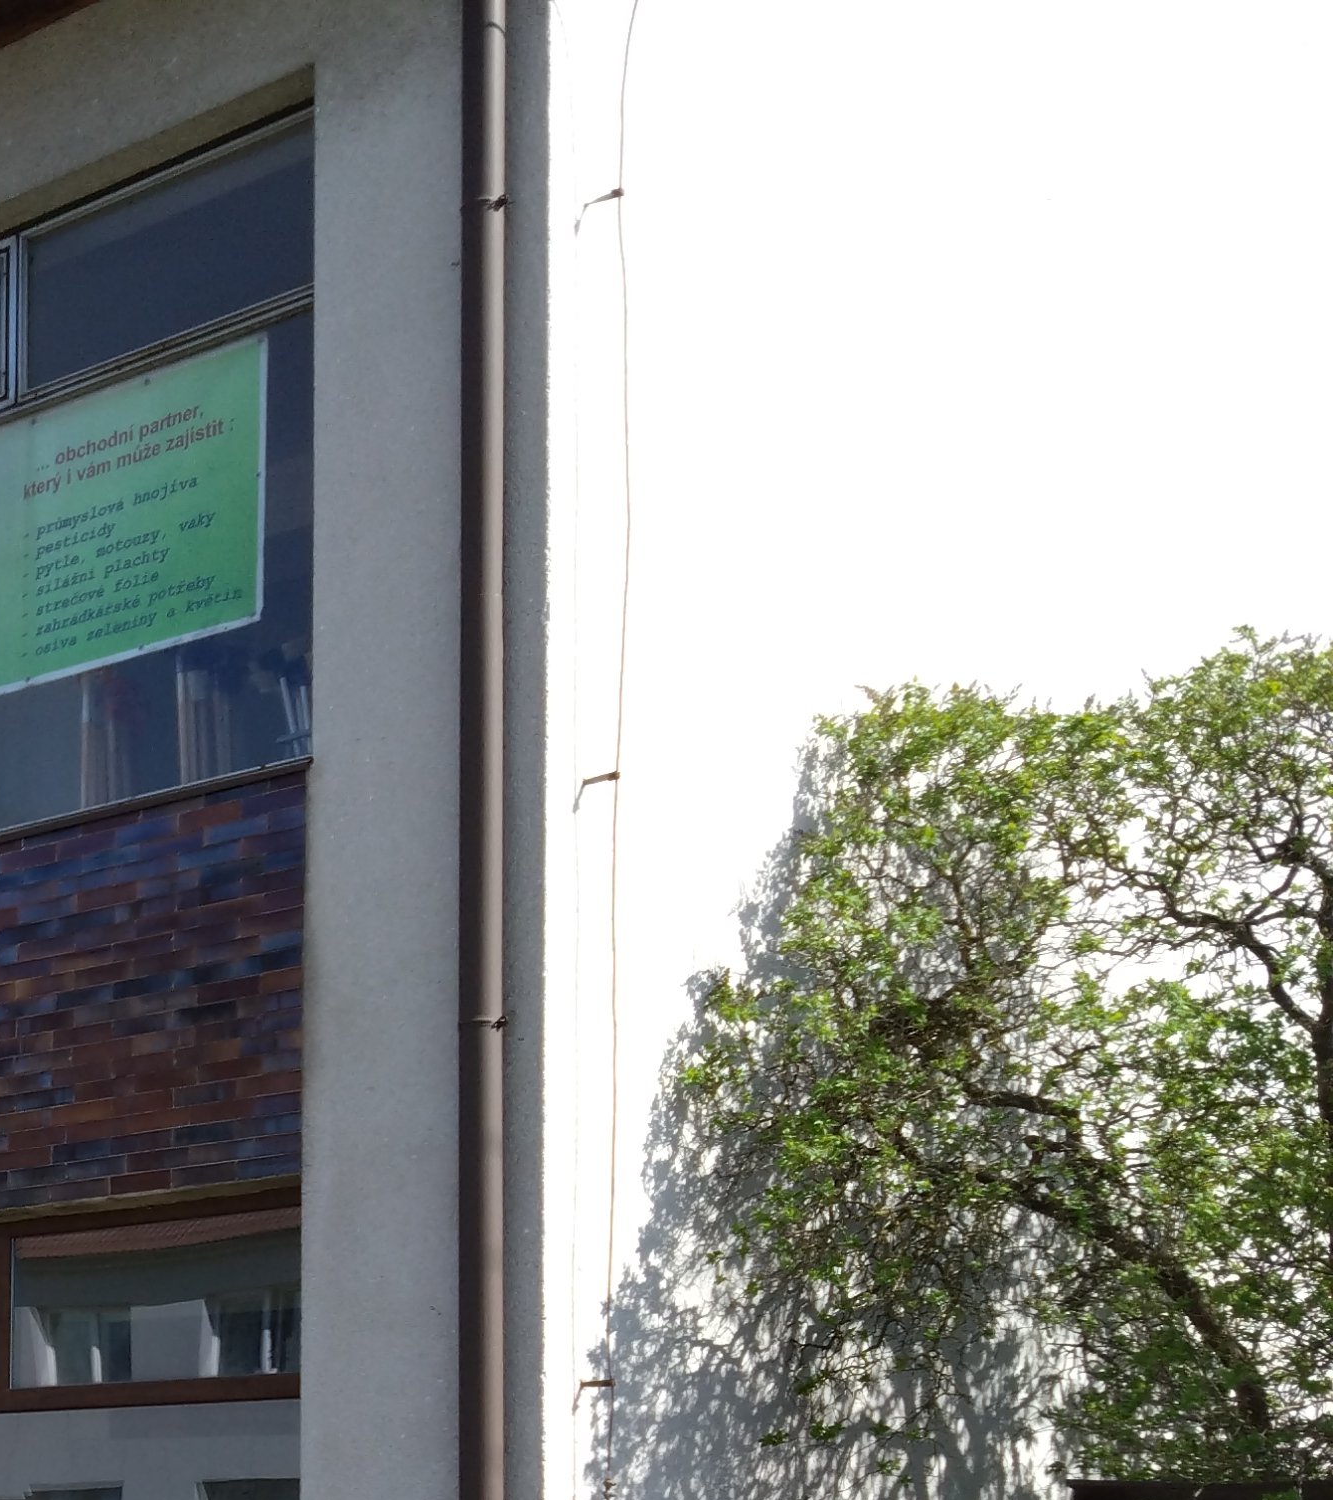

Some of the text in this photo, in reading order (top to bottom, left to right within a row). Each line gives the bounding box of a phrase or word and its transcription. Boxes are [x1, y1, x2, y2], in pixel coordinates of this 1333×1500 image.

[54, 424, 134, 465] obchodní
[138, 405, 204, 443] partner,
[23, 470, 62, 500] který
[66, 468, 72, 485] i
[76, 458, 111, 482] vám
[165, 418, 225, 452] zajistit
[178, 511, 217, 533] vaky
[35, 521, 117, 561] pesticidy
[103, 546, 171, 581] plachty
[34, 637, 78, 657] osiva
